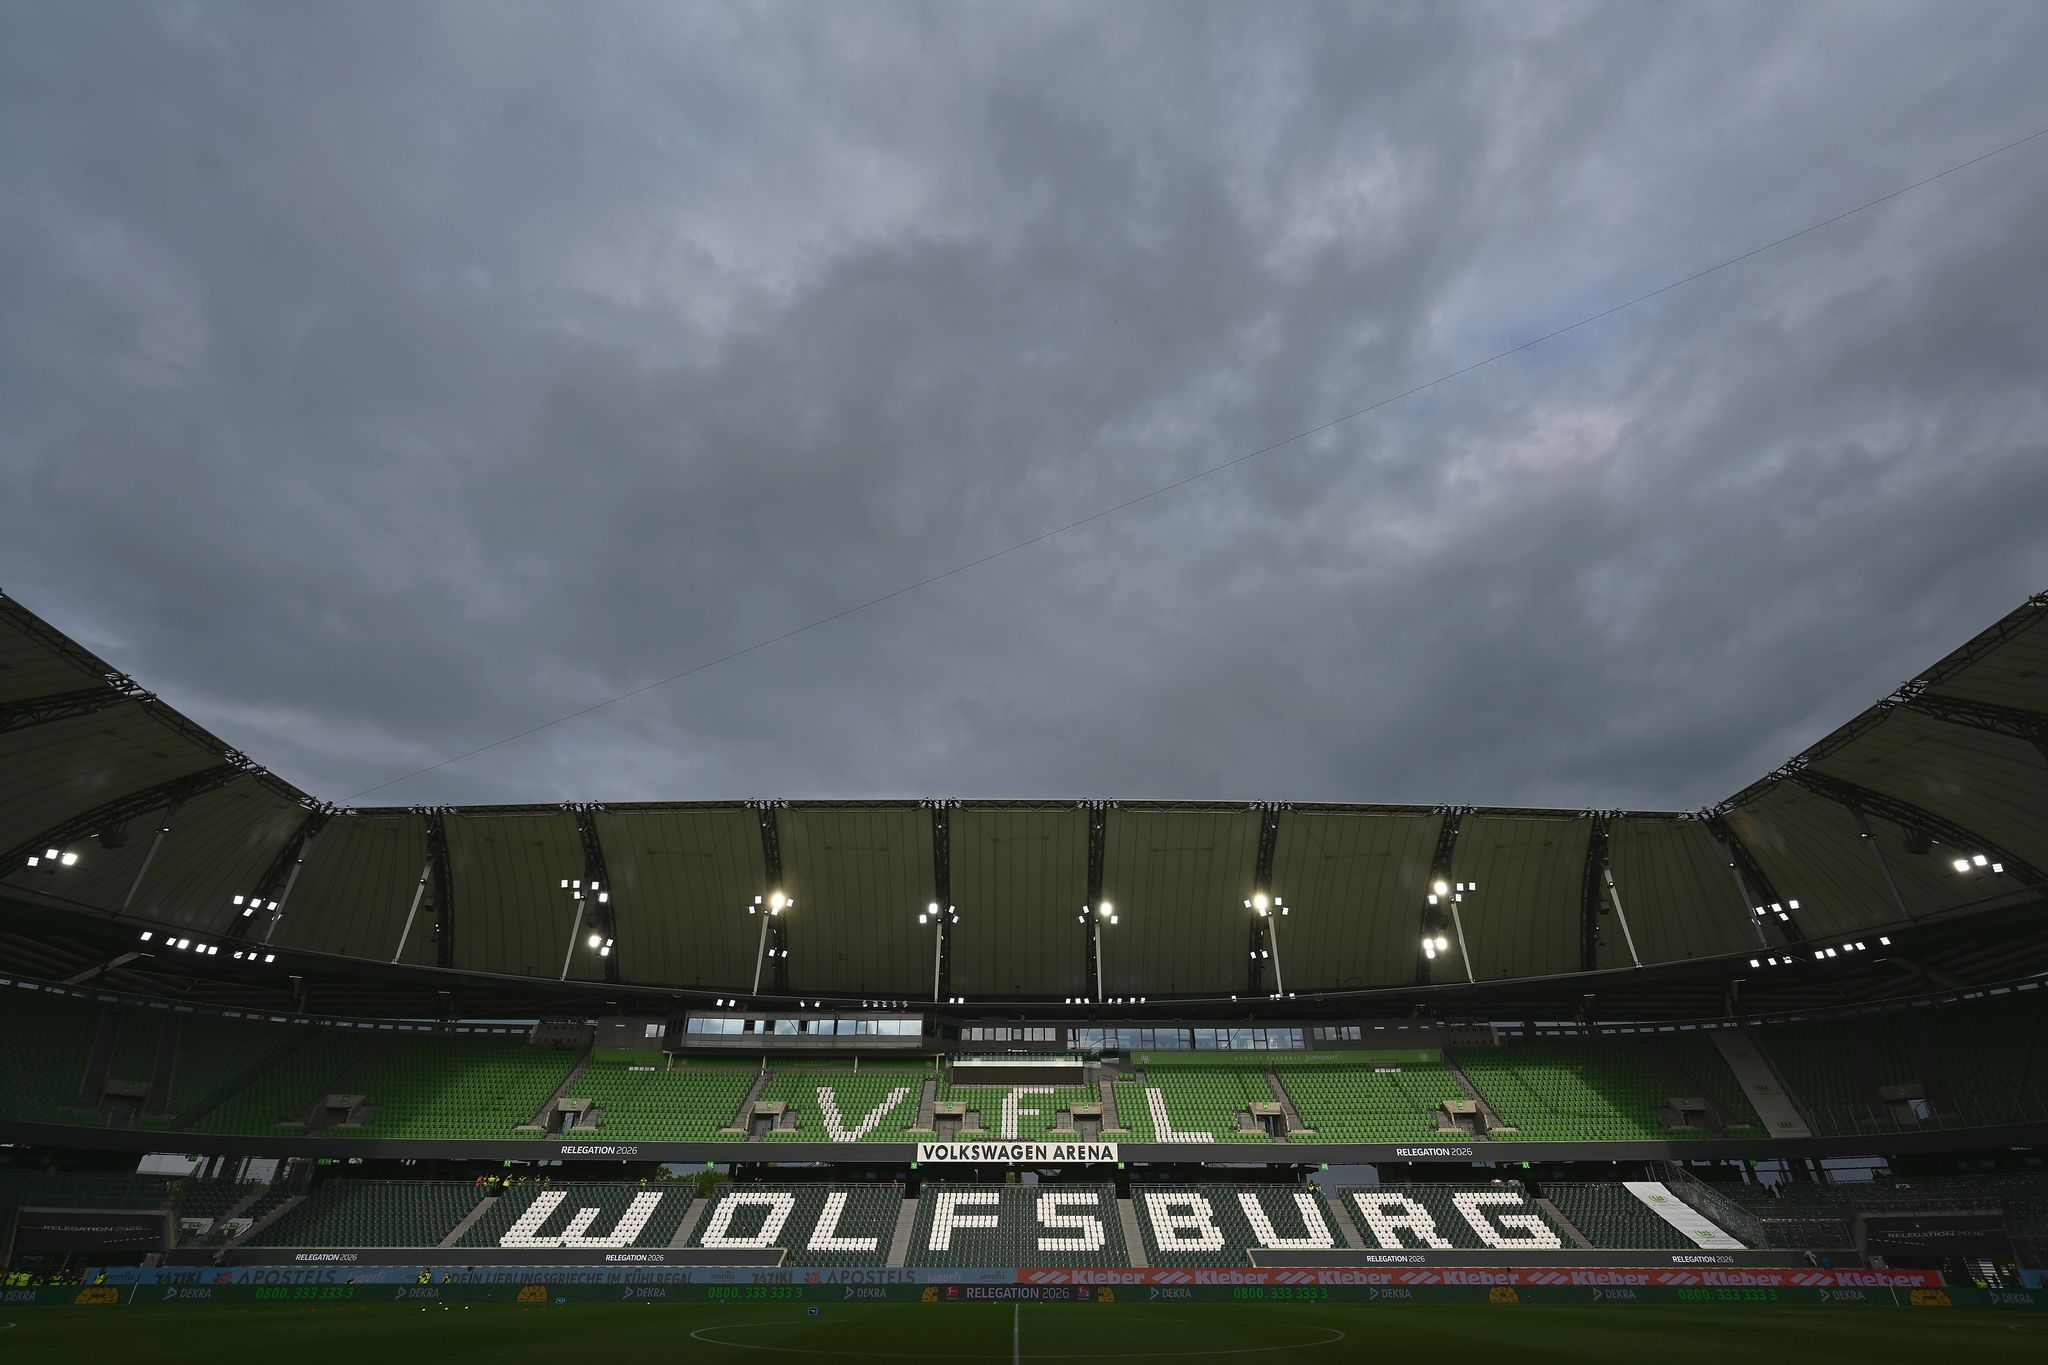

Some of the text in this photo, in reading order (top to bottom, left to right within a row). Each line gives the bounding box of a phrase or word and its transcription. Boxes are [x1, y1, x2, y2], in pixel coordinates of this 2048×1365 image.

[561, 1146, 638, 1155] RELEGATION 2026
[923, 1144, 1114, 1160] VOLKSWAGEN ARENA
[1396, 1148, 1473, 1156] RELEGATION 2026
[500, 1191, 1562, 1251] WOLFSBURG
[1888, 1230, 1955, 1239] RELEGATION
[295, 1253, 358, 1261] RELEGATION 2026
[606, 1254, 665, 1262] RELEGATION 2026
[1366, 1255, 1425, 1263] RELEGATION 2026
[1672, 1255, 1734, 1264] RELEGATION 2026
[237, 1270, 337, 1285] APOSTELS
[452, 1272, 483, 1285] DEIN
[607, 1271, 621, 1285] IM
[826, 1270, 916, 1284] APOSTELS
[1072, 1270, 1145, 1284] Kleber
[1195, 1270, 1268, 1284] Kleber
[1318, 1270, 1392, 1285] Kleber
[1442, 1270, 1520, 1285] Kleber
[1570, 1271, 1650, 1286] Kleber
[1701, 1271, 1783, 1286] Kleber
[1833, 1272, 1927, 1287] Kleber
[4, 1290, 37, 1300] DEKRA
[179, 1287, 212, 1298] DEKRA
[294, 1287, 317, 1299] 333
[319, 1287, 343, 1299] 333
[344, 1287, 355, 1299] 3
[409, 1288, 439, 1297] DEKRA
[636, 1287, 666, 1297] DEKRA
[745, 1287, 767, 1298] 333
[770, 1287, 792, 1298] 333
[796, 1287, 803, 1298] 3
[857, 1288, 887, 1298] DEKRA
[966, 1287, 1070, 1299] RELEGATION 2026
[1162, 1288, 1192, 1298] DEKRA
[1271, 1287, 1292, 1298] 333
[1296, 1287, 1317, 1298] 333
[1319, 1287, 1329, 1298] 3
[1381, 1288, 1412, 1298] DEKRA
[1604, 1289, 1636, 1299] DEKRA
[1718, 1288, 1740, 1300] 333
[1743, 1288, 1766, 1300] 333
[1768, 1288, 1777, 1300] 3
[1832, 1290, 1866, 1300] DEKRA
[2001, 1293, 2035, 1304] DEKRA
